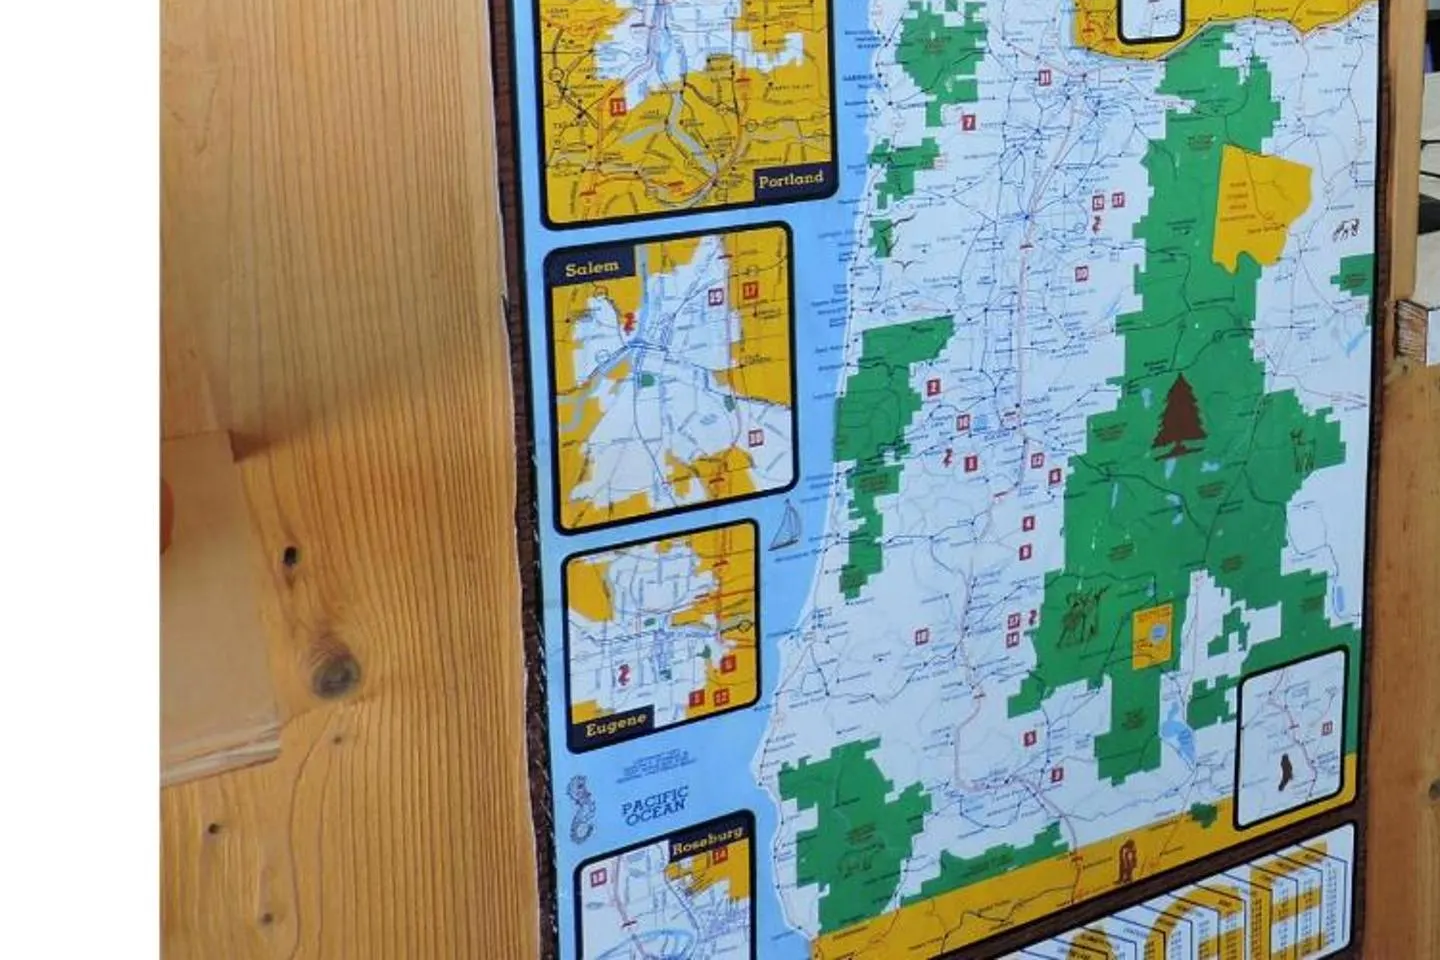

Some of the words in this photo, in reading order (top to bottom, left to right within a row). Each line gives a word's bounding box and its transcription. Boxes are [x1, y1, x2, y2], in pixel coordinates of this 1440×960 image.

[758, 170, 824, 189] Portland
[565, 260, 620, 278] Salem
[584, 713, 648, 738] Eugene
[621, 786, 690, 817] PACIFIC
[625, 797, 687, 827] OCEAN
[672, 825, 745, 856] Roseburg
